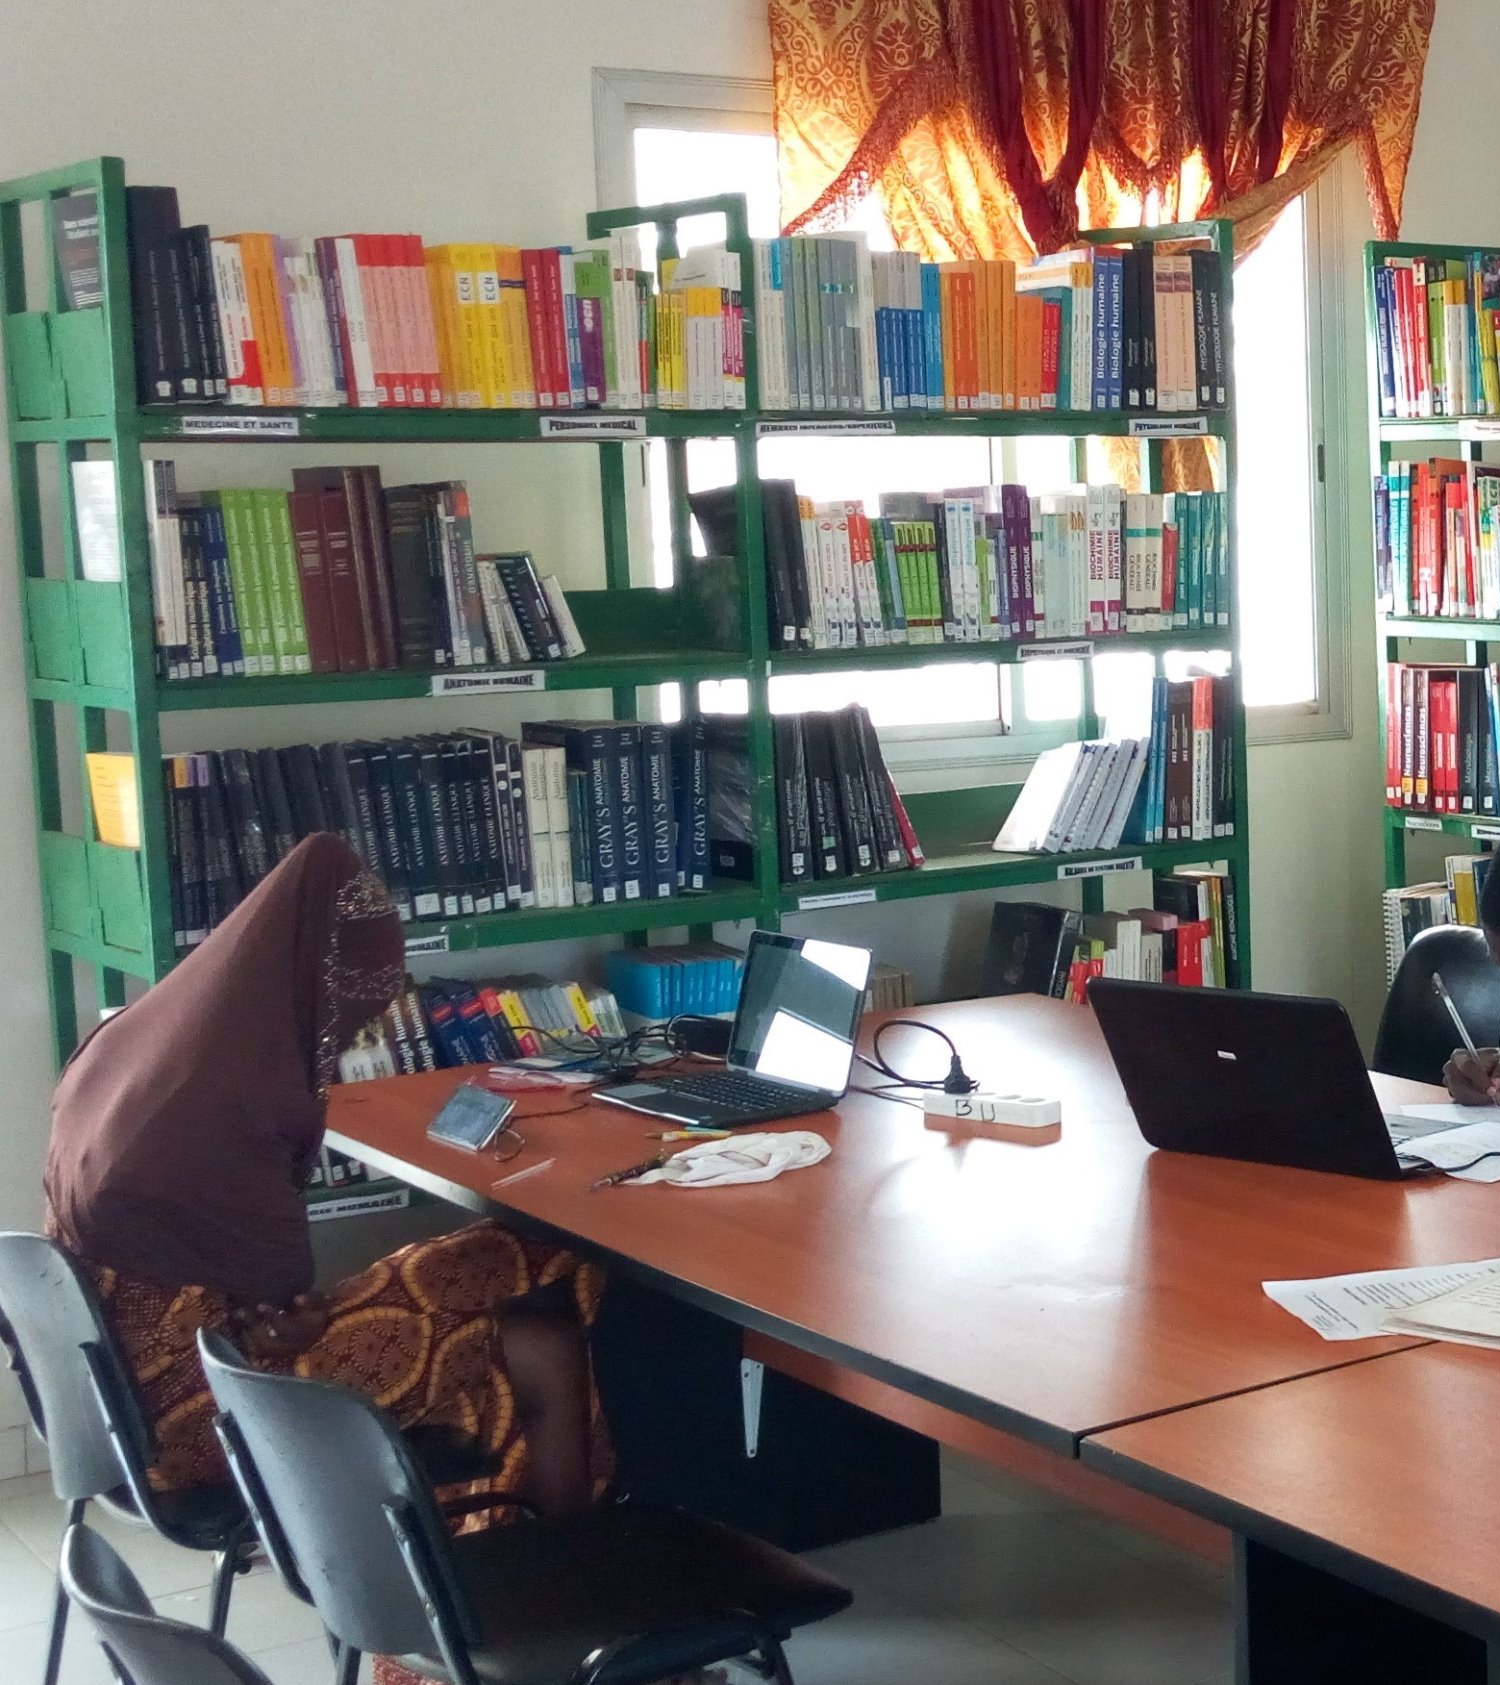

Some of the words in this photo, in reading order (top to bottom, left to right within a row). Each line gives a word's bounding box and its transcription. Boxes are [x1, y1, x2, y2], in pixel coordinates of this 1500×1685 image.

[460, 278, 470, 300] ECN
[484, 278, 496, 300] ECN
[1097, 274, 1105, 327] humaine
[1111, 275, 1119, 327] humaine
[1097, 331, 1107, 378] Biologie
[1111, 331, 1121, 378] Biologie
[185, 420, 241, 430] MEDECINE
[244, 420, 256, 429] ET
[259, 420, 294, 429] SANTE
[599, 419, 637, 431] MEDICAL
[1010, 546, 1019, 598] BIOPHYSIQUE
[1023, 546, 1032, 598] BIOPHYSIQUE
[593, 758, 603, 805] ANATOMIE
[620, 756, 630, 802] ANATOMIE
[651, 754, 660, 800] ANATOMIE
[1464, 734, 1472, 783] Microbiologie
[596, 808, 614, 868] GRAY'S
[623, 805, 639, 865] GRAY'S
[653, 803, 669, 863] GRAY'S
[694, 797, 706, 855] GRAY'S
[389, 1000, 406, 1040] humain
[405, 992, 425, 1037] humaine
[400, 1042, 415, 1074] ologie
[418, 1039, 435, 1071] ologie
